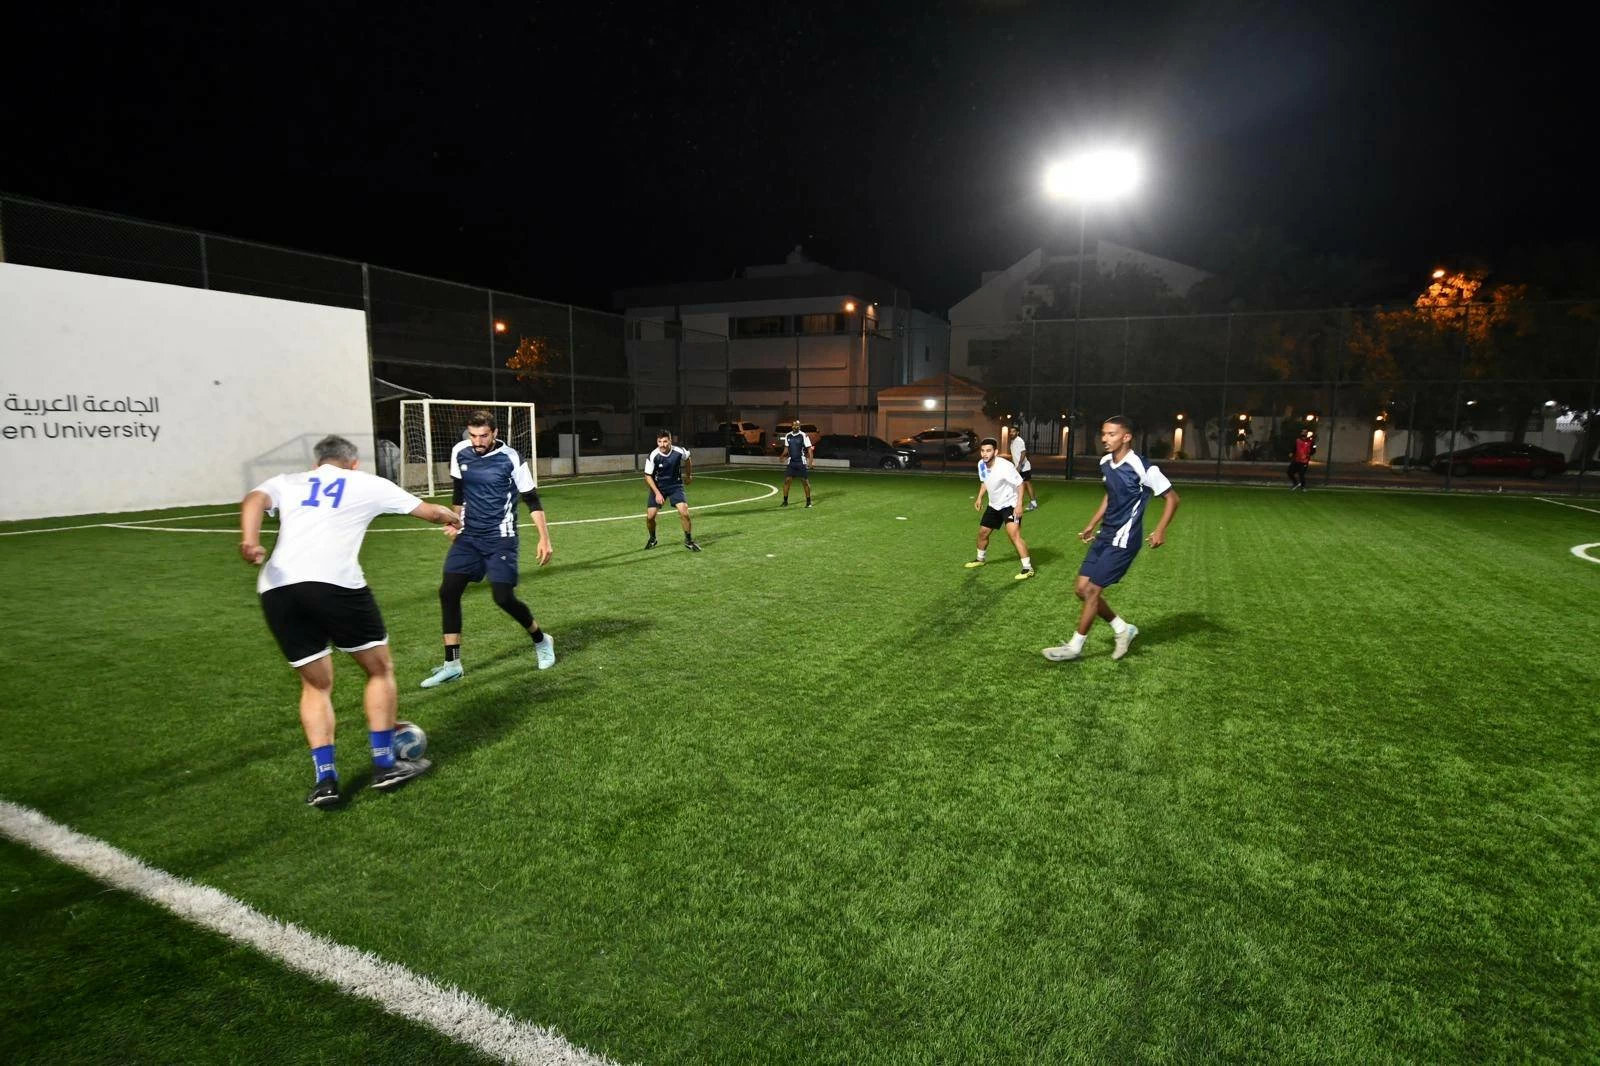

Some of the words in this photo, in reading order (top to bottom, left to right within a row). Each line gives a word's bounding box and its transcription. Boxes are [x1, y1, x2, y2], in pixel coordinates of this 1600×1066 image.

[3, 393, 79, 417] العربية
[83, 395, 160, 417] الجامعة
[43, 421, 161, 443] University
[301, 477, 347, 509] 14
